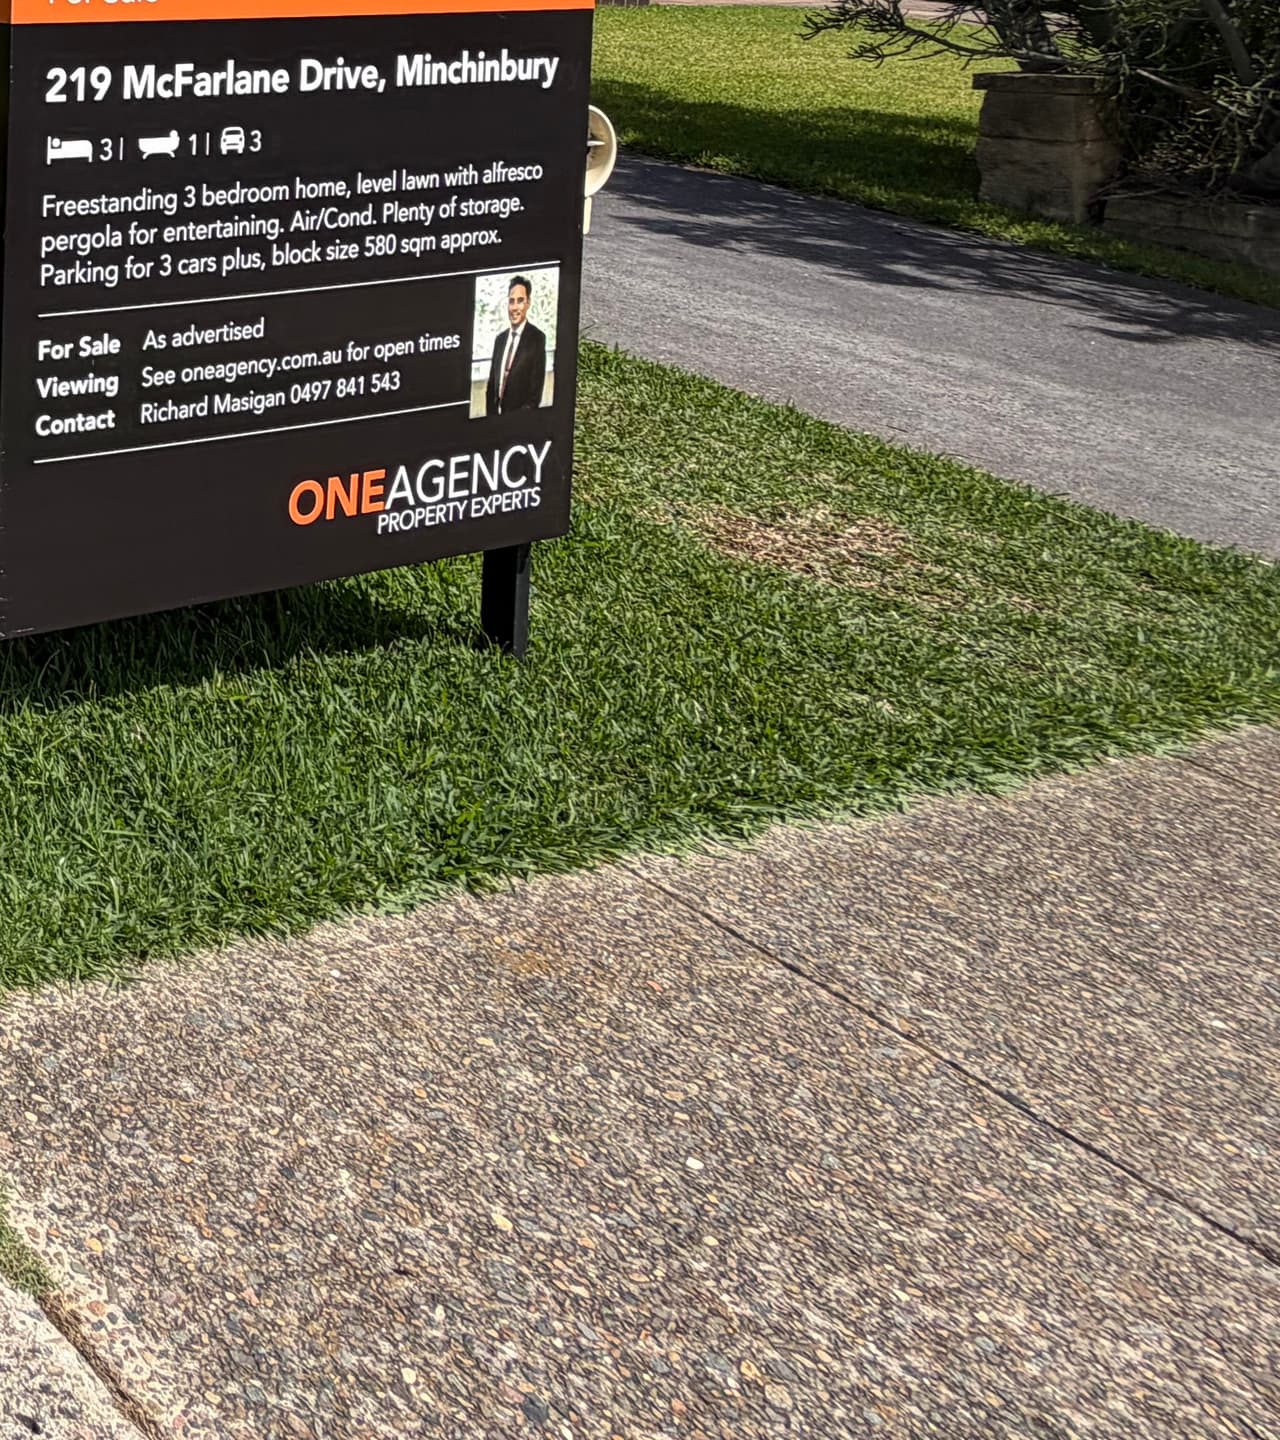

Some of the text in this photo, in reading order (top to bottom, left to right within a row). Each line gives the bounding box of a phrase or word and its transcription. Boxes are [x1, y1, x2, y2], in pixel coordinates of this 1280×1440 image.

[45, 48, 560, 103] 219 McFarlane Drive, Minchinbury
[42, 160, 543, 218] Freestanding 3 bedroom home, level lawn with alfresco
[40, 195, 525, 259] pergola for entertaining. Air/Cond. Plenty of storage.
[40, 229, 502, 288] Parking for 3 cars plus, block size 580 sqm approx.
[38, 332, 121, 362] For Sale
[141, 332, 461, 388] See oneagency.com.au for open times
[142, 316, 265, 351] As advertised
[36, 372, 119, 399] Viewing
[140, 370, 401, 424] Richard Masigan 0497 841 543
[35, 409, 116, 437] Contact
[376, 486, 541, 535] PROPERTY EXPERTS
